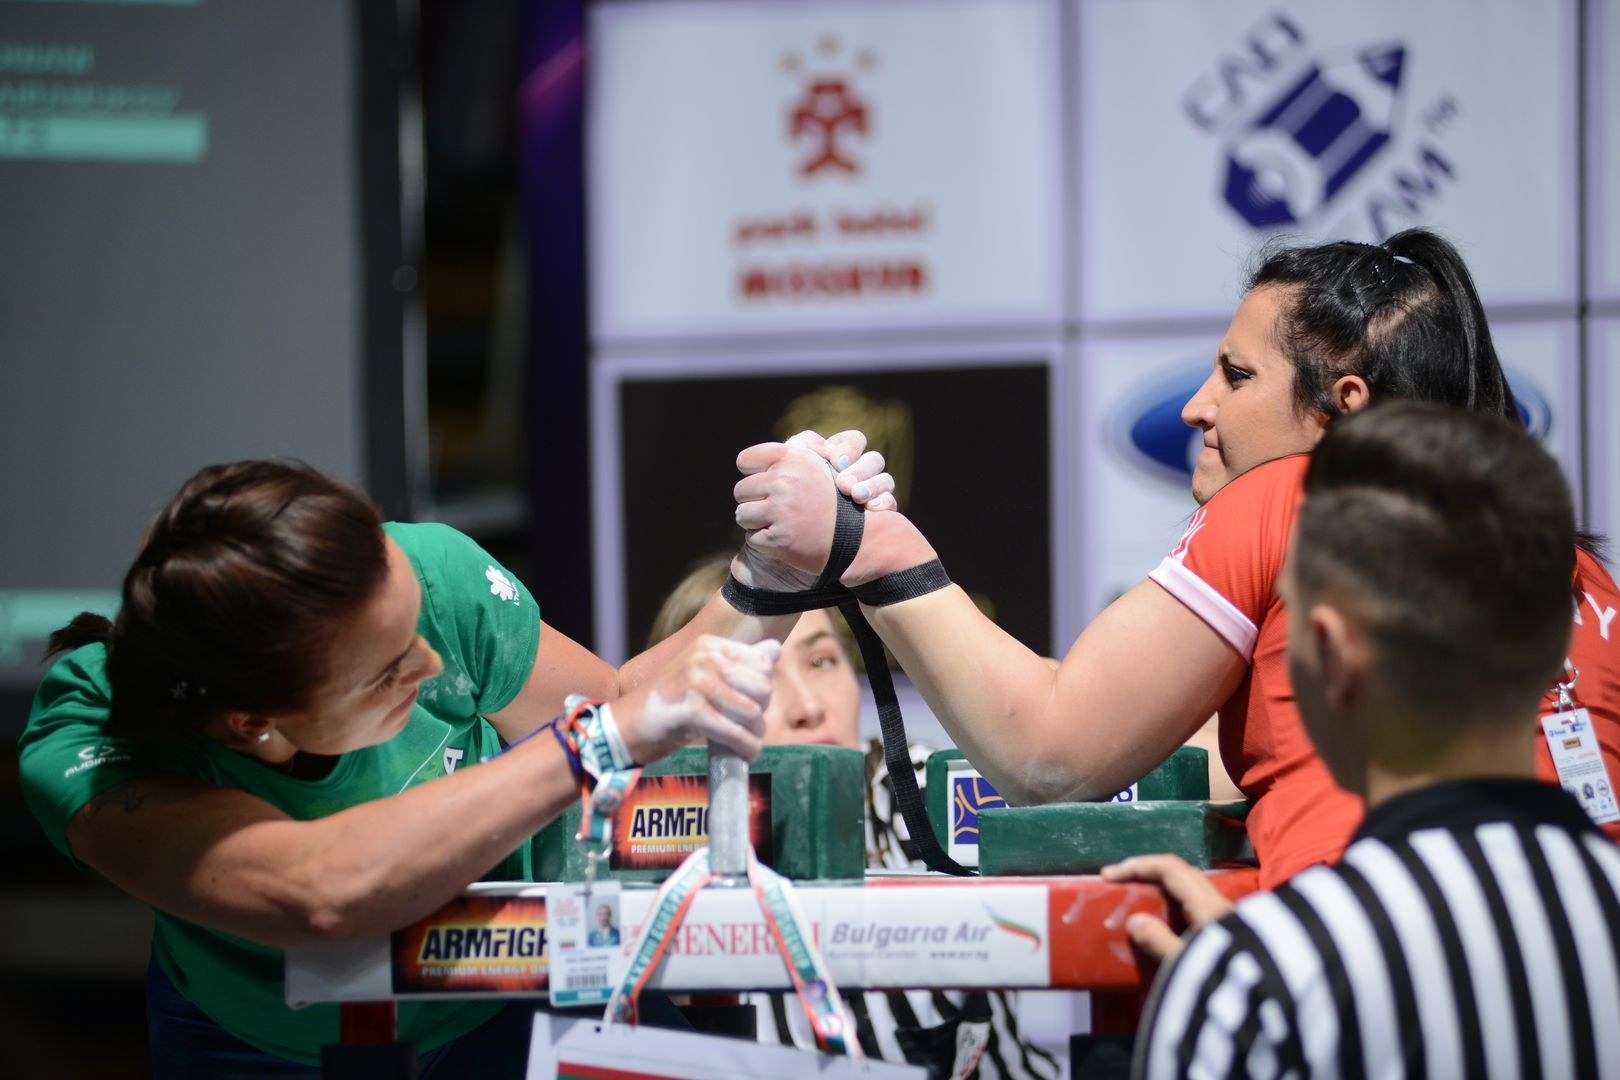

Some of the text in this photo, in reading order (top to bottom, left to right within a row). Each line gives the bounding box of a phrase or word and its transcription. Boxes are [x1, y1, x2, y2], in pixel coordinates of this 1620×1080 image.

[631, 806, 709, 838] ARMFI
[421, 926, 549, 961] ARMFIGH
[831, 921, 993, 950] Bulgaria Air
